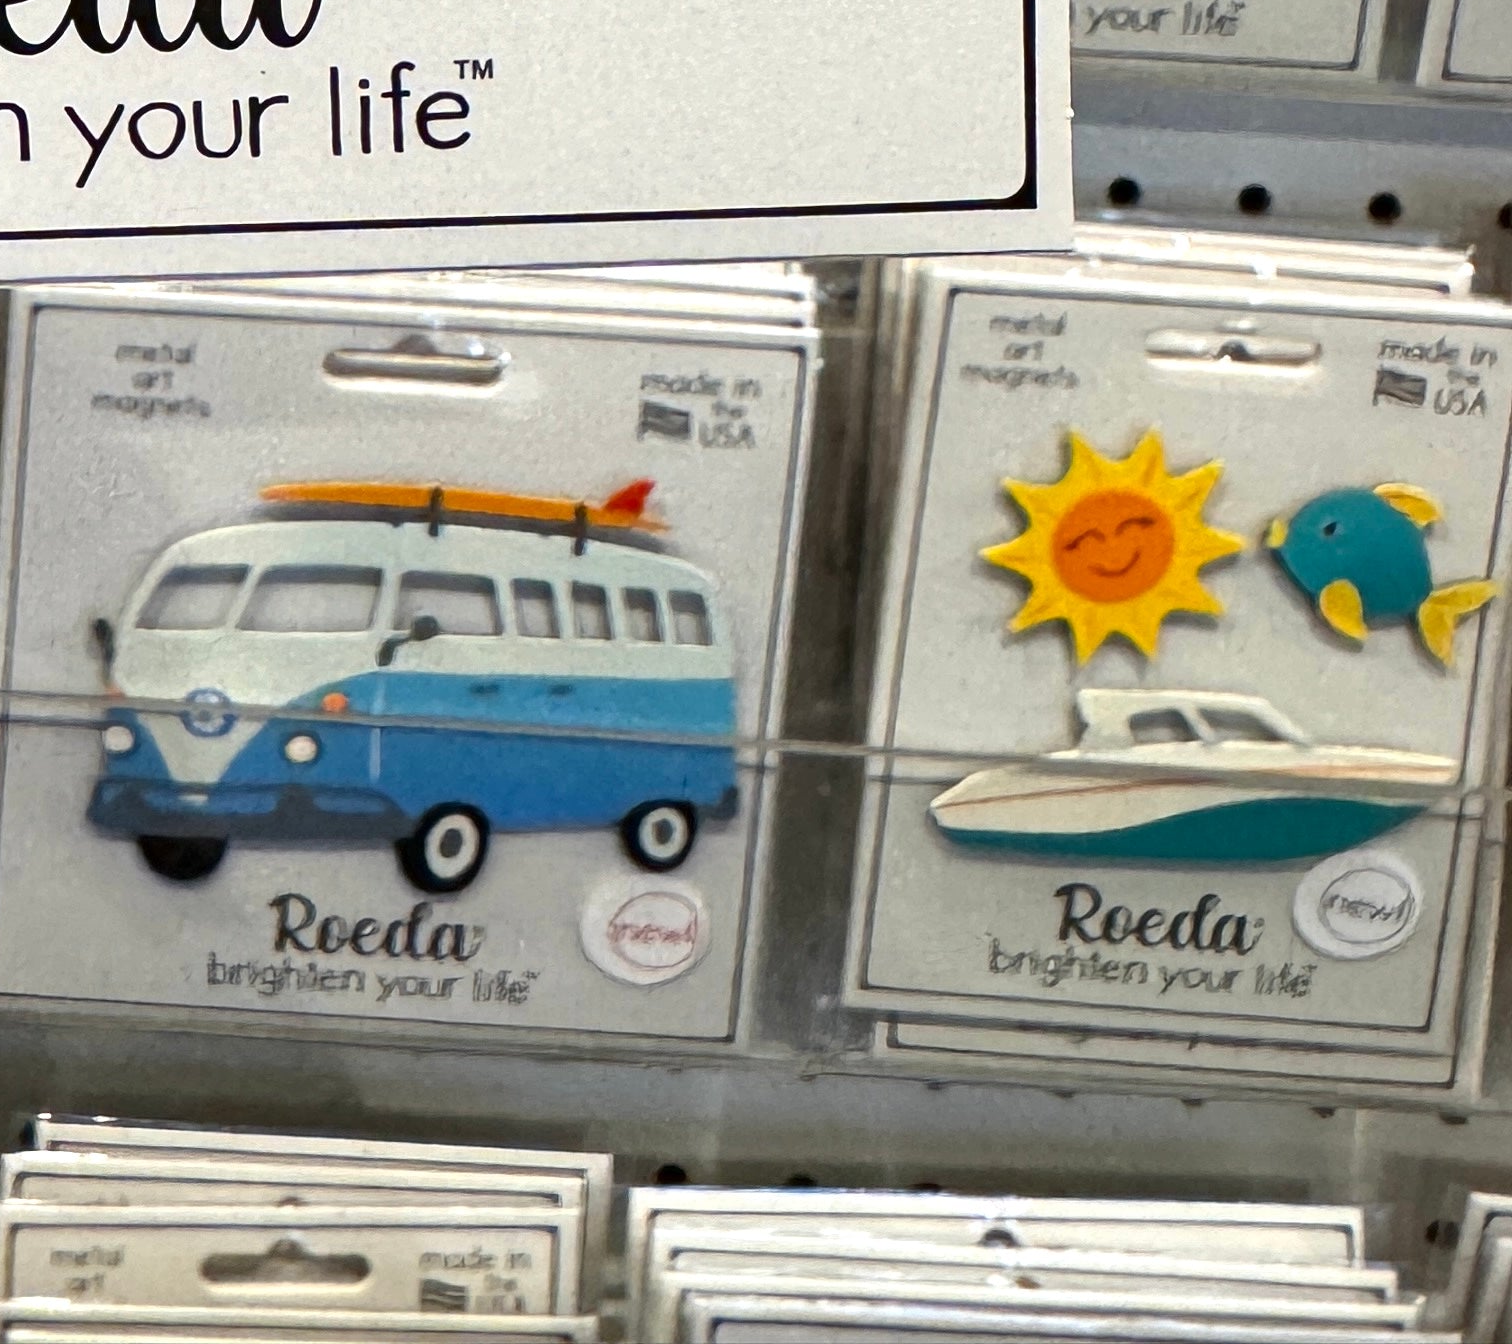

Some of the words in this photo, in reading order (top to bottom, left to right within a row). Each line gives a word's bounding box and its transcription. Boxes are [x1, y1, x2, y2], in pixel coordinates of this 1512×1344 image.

[63, 92, 290, 189] your
[375, 973, 464, 1003] your
[1158, 964, 1244, 996] your
